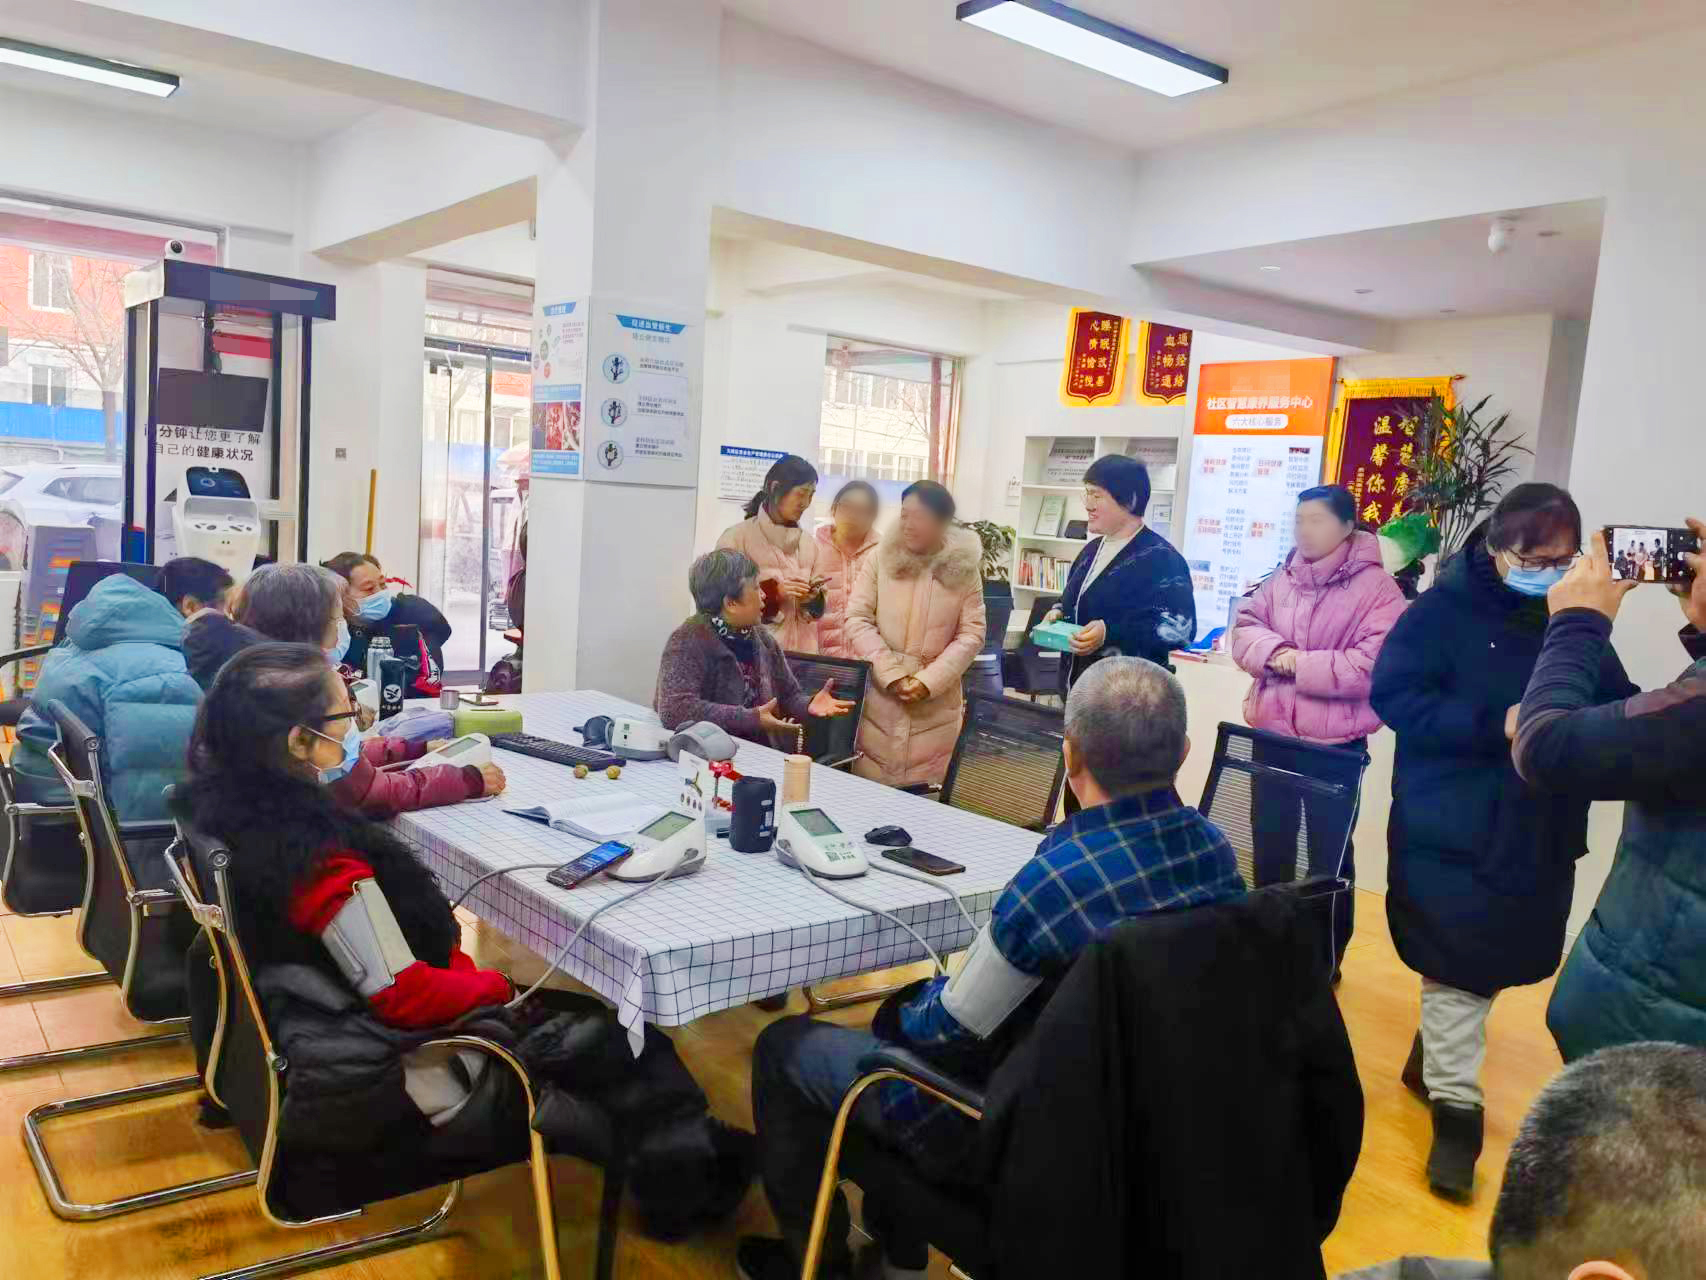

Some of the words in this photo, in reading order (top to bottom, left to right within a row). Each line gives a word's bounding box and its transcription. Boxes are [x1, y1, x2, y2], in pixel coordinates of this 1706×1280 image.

[1206, 395, 1313, 410] 社区智慧康养服务中心
